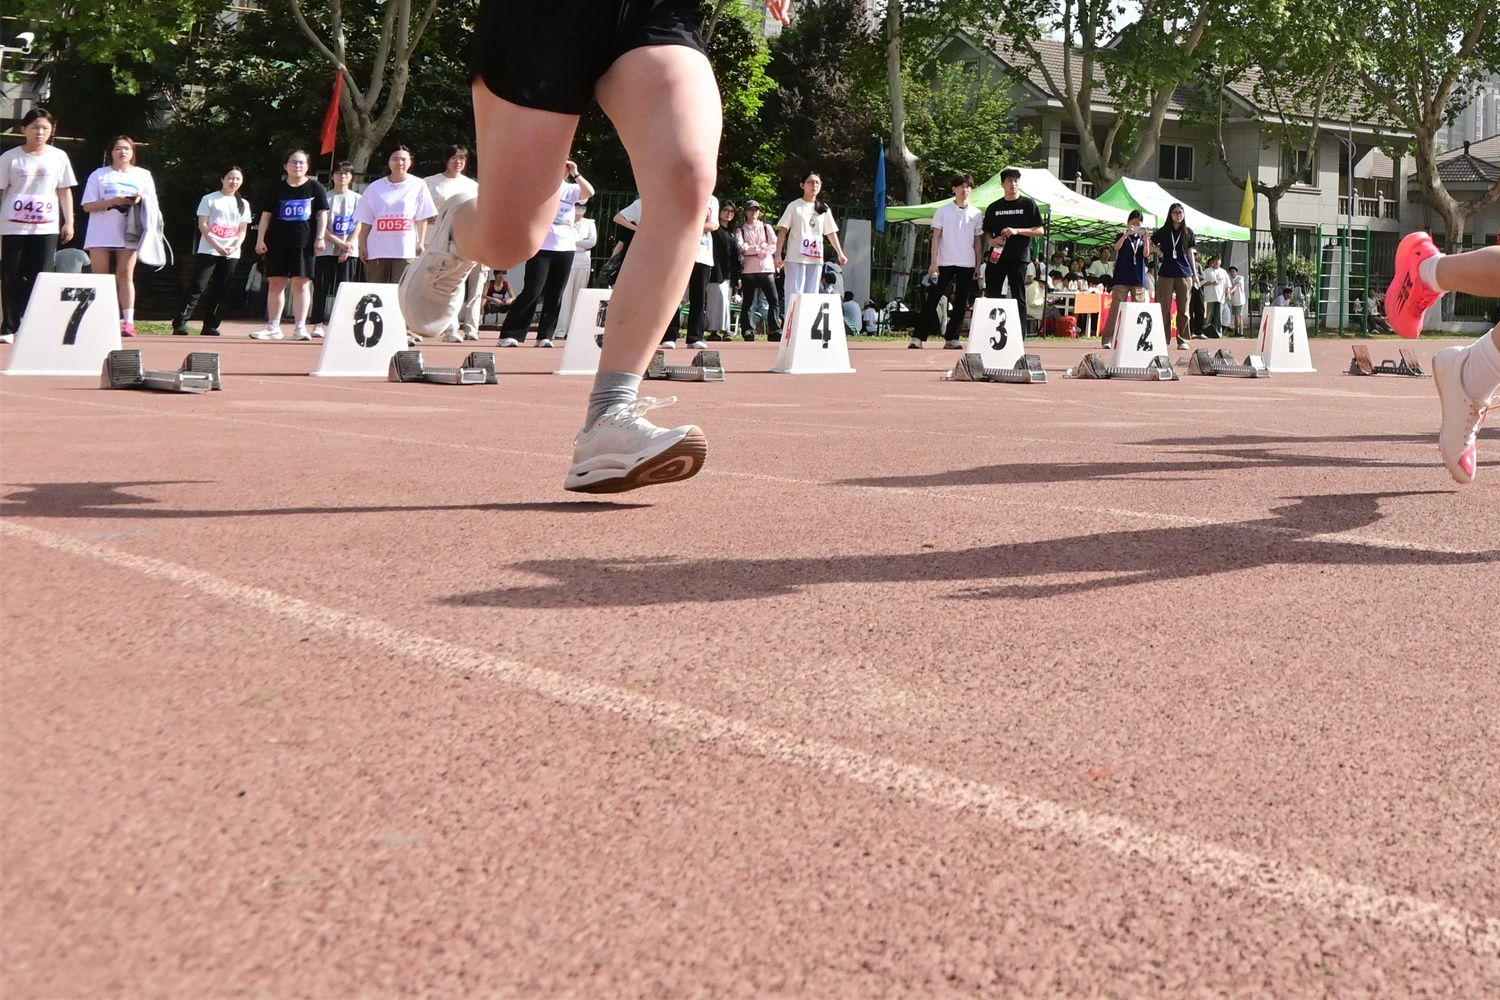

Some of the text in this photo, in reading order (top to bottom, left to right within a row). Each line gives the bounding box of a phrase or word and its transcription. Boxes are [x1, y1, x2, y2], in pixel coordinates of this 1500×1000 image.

[13, 200, 53, 214] 0429
[379, 220, 411, 231] 0052
[60, 287, 96, 345] 7
[353, 293, 383, 348] 6
[811, 302, 831, 349] 4
[989, 307, 1008, 351] 3
[1136, 311, 1153, 351] 2
[1283, 315, 1295, 353] 1
